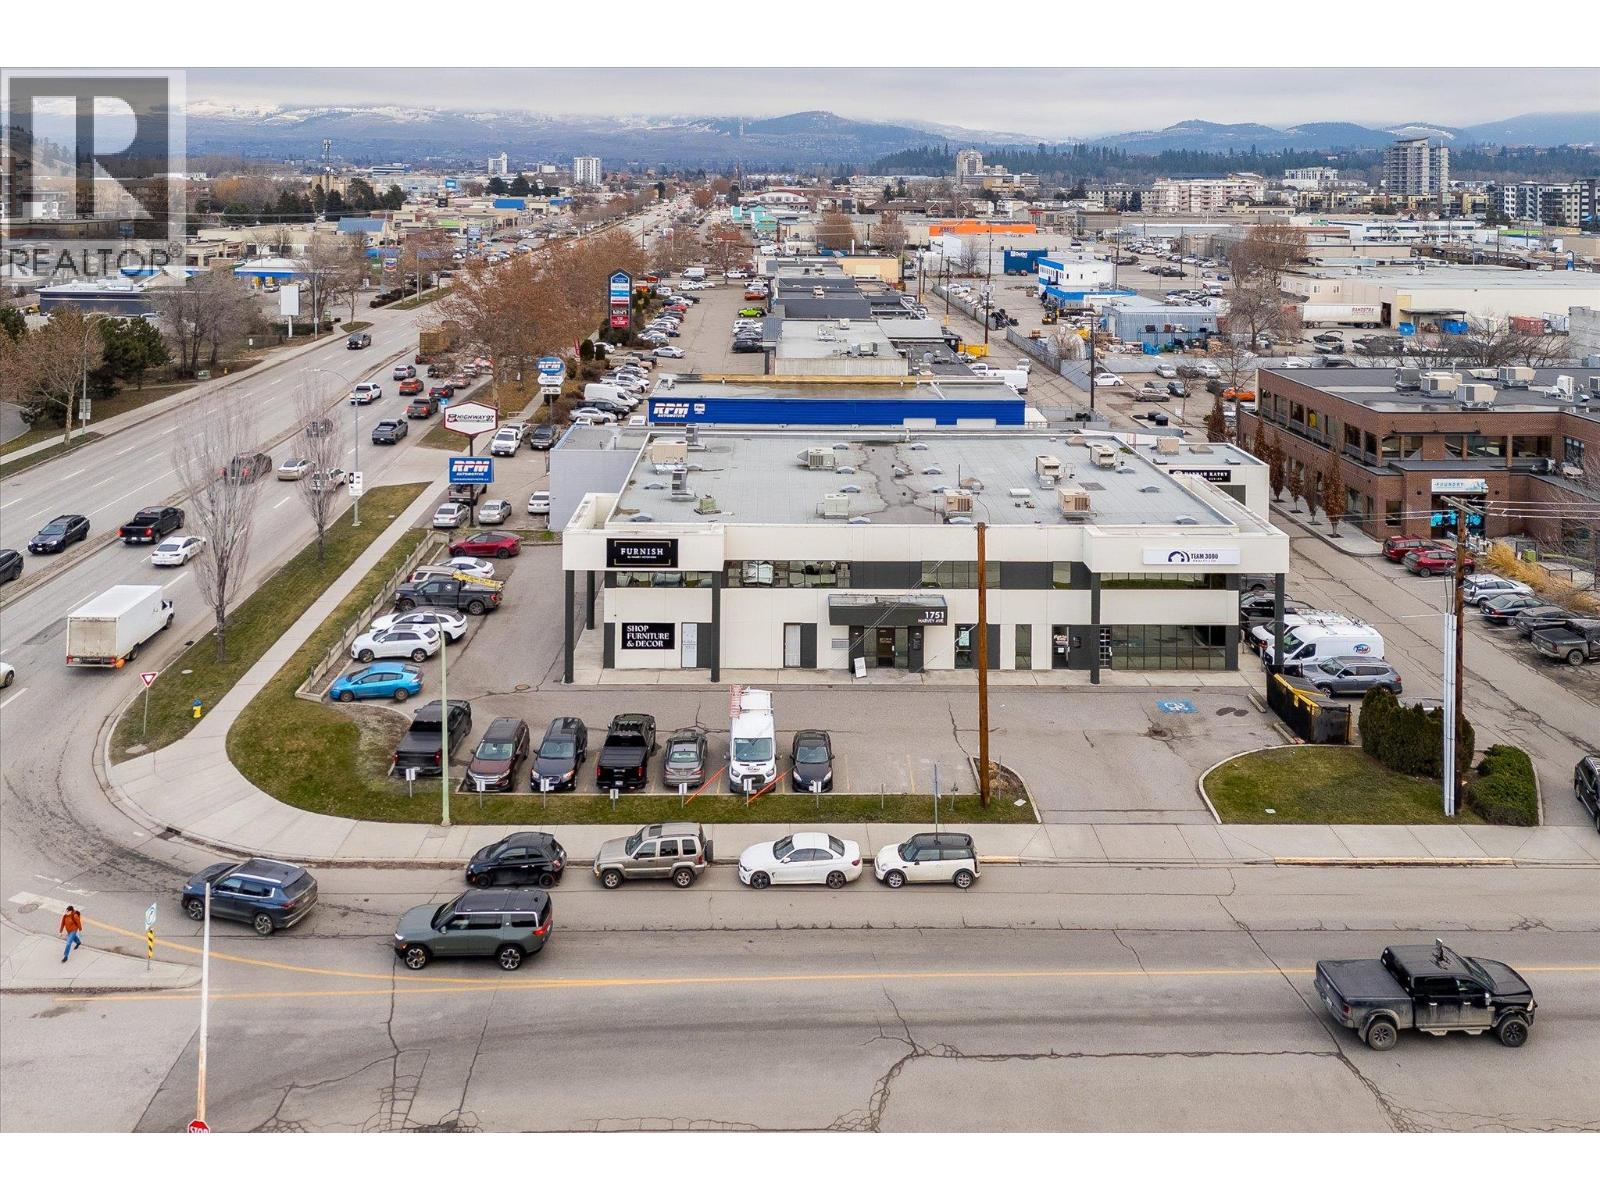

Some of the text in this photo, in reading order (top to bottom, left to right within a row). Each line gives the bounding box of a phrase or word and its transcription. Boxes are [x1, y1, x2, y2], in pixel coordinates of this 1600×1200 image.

[653, 402, 690, 415] RPM
[452, 460, 490, 472] RPM
[620, 547, 664, 556] FURNISH
[925, 611, 944, 619] 1751
[626, 632, 670, 640] FURNITURE
